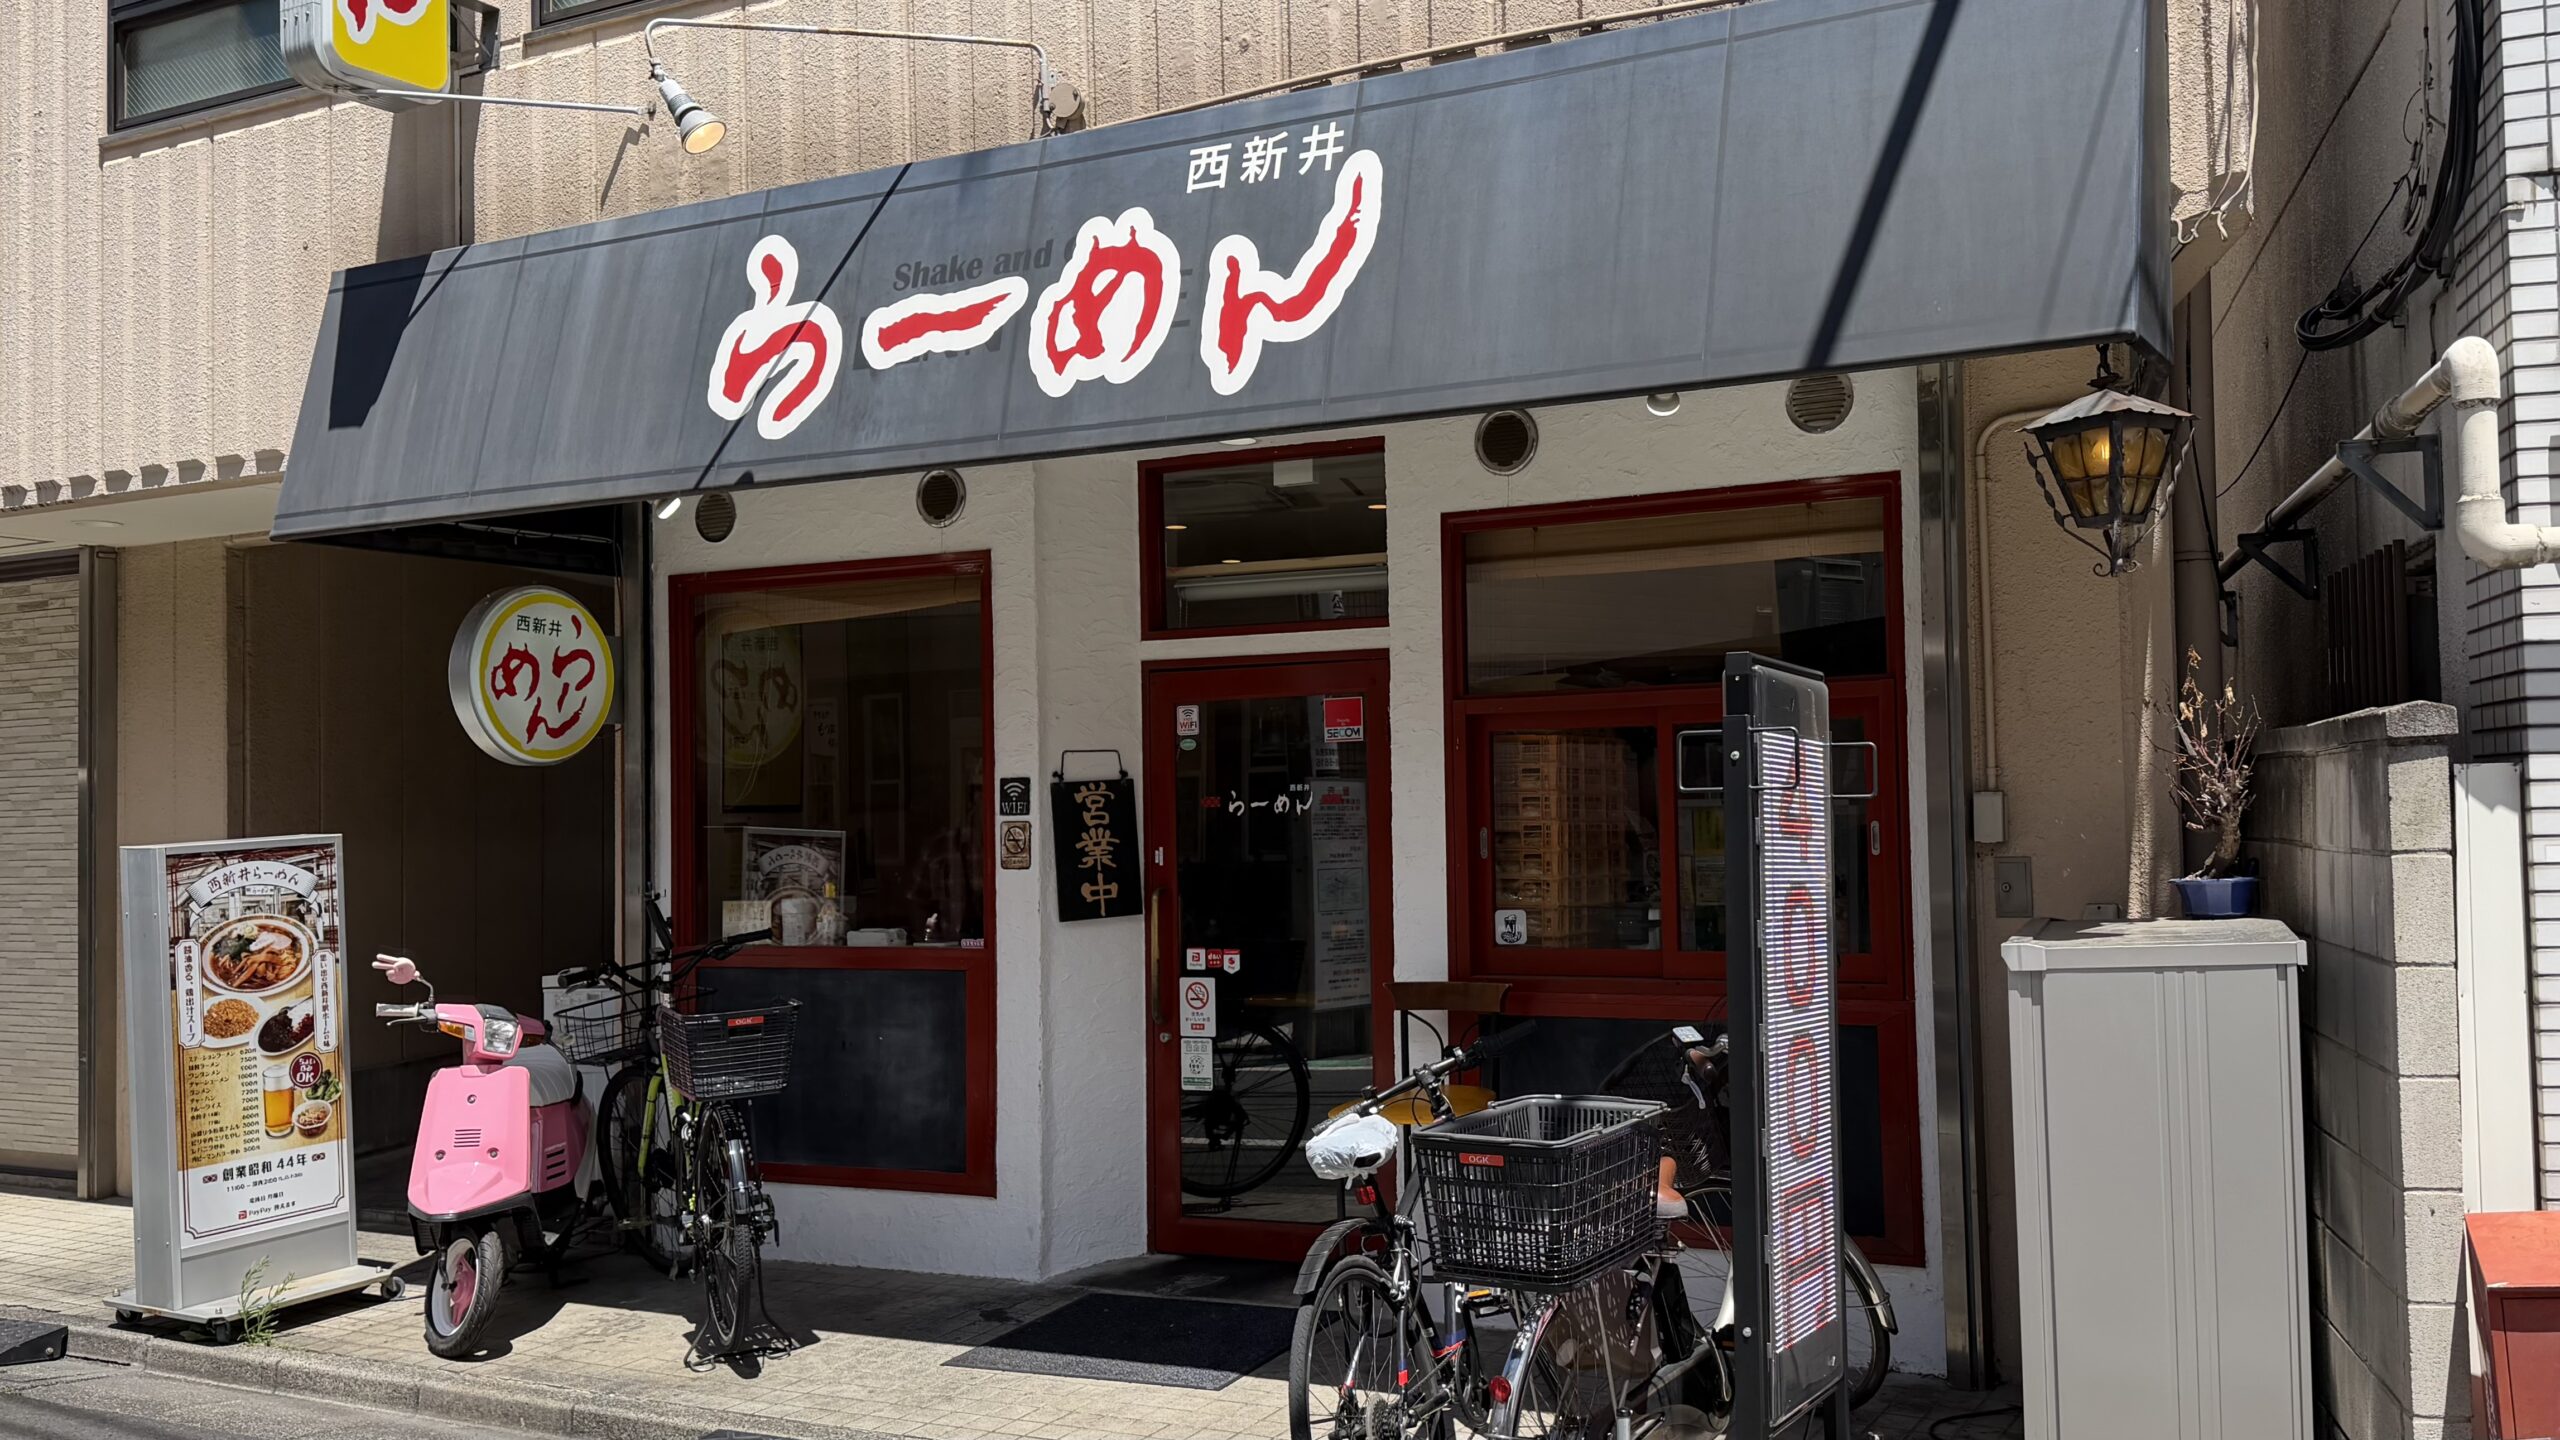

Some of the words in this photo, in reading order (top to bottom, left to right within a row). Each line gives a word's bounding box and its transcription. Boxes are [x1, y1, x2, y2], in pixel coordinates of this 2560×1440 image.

[1186, 122, 1345, 193] 西新井
[892, 259, 983, 291] Shake
[992, 244, 1051, 274] and
[708, 150, 1383, 440] らーめん
[516, 614, 563, 638] 西新井
[1326, 727, 1361, 738] SECOM
[1289, 784, 1310, 792] 西新井
[1002, 802, 1028, 814] WIFI
[1228, 790, 1313, 816] らーめん
[1074, 782, 1120, 918] 営業中
[208, 866, 300, 894] 西新井らーめん
[296, 1072, 315, 1083] OK
[222, 1160, 272, 1182] 創業昭和
[276, 1154, 308, 1170] 44年
[1468, 1155, 1489, 1164] OGK
